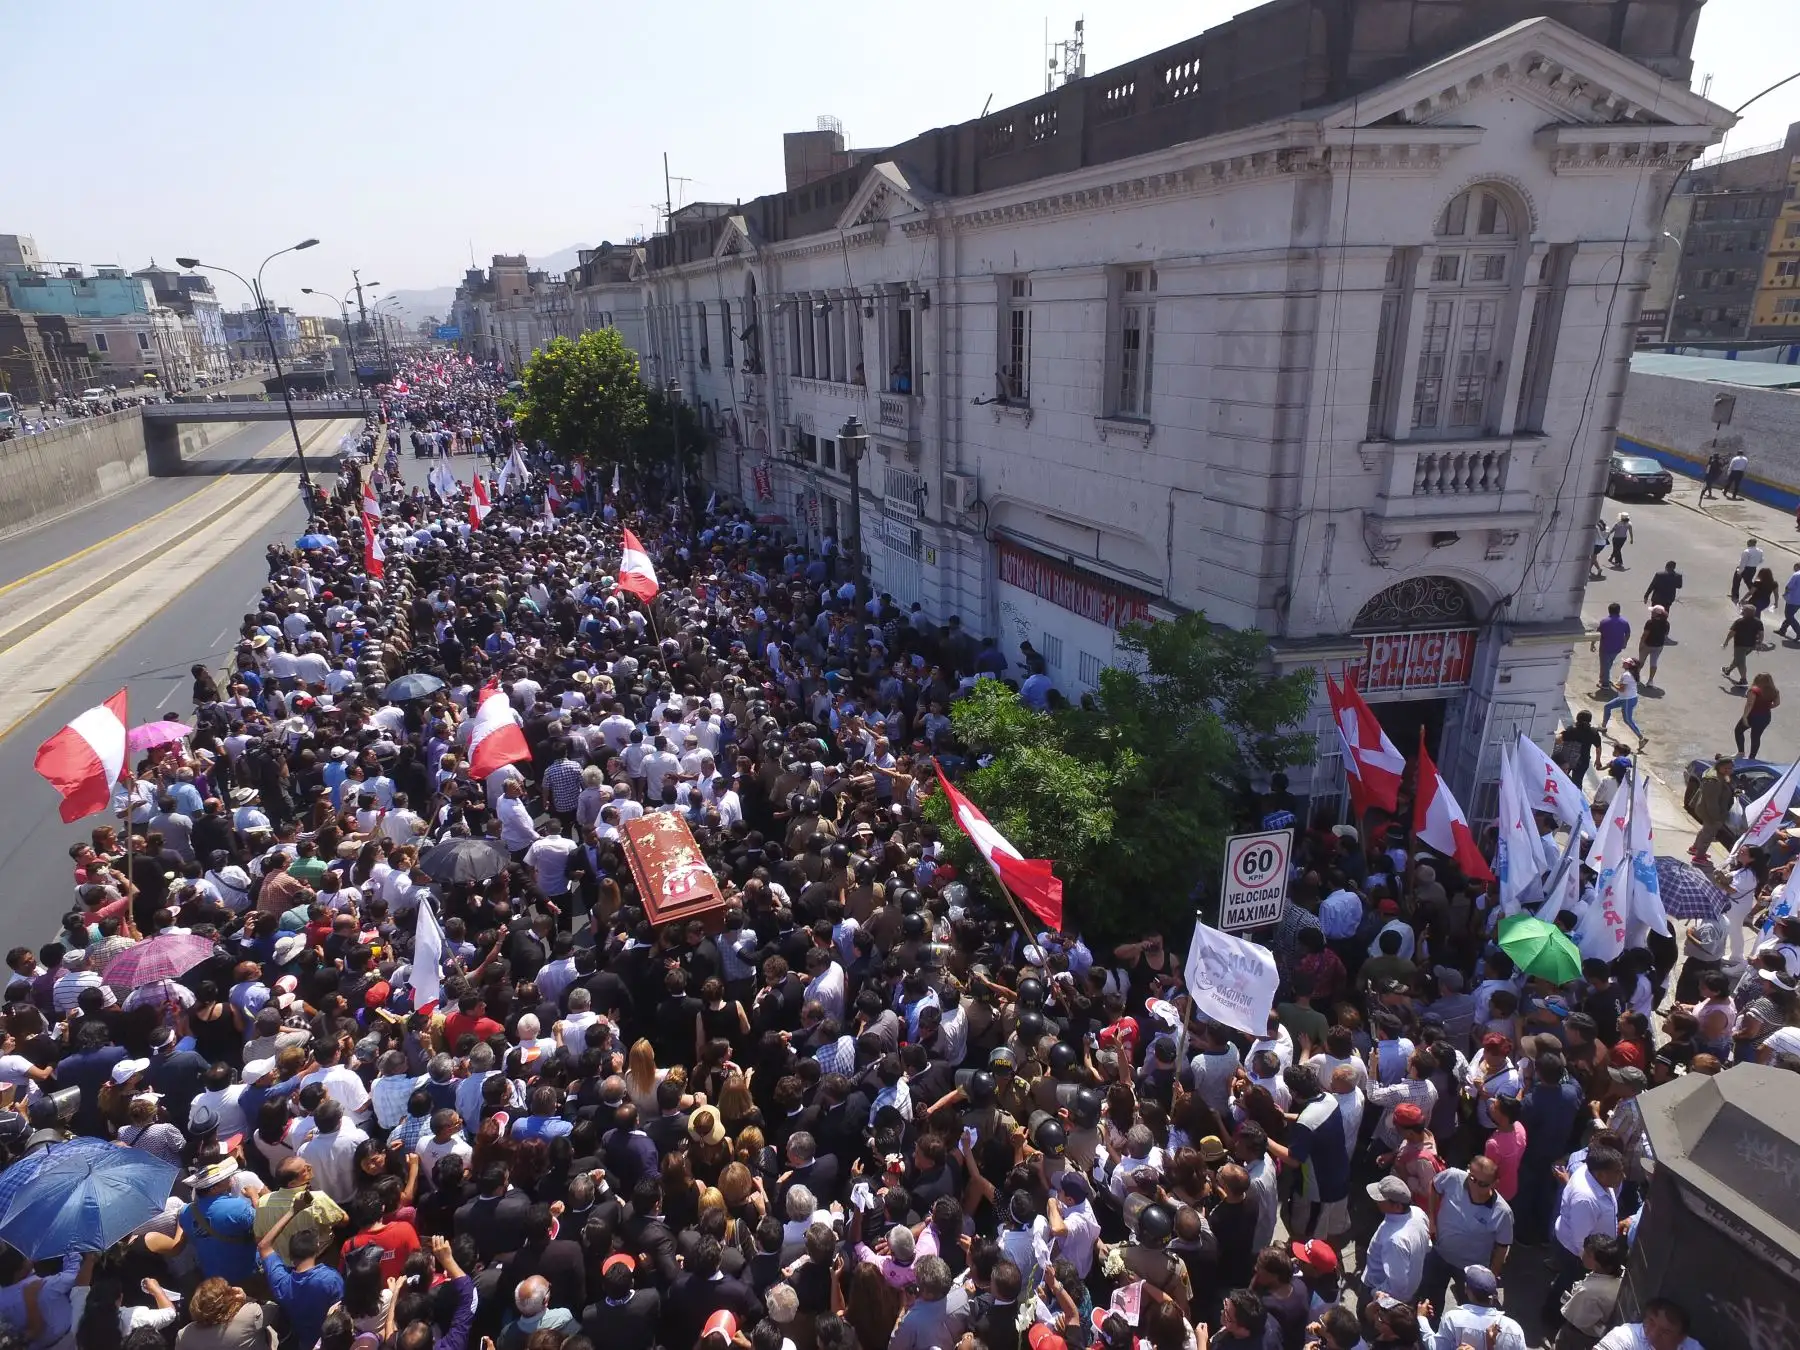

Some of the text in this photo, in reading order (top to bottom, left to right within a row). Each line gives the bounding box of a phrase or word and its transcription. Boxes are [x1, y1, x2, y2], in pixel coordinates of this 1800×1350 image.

[1002, 552, 1035, 593] BOTICAS
[1360, 664, 1448, 682] 24 HORAS
[1242, 849, 1273, 875] 60
[1229, 887, 1280, 905] VELOCIDAD
[1227, 903, 1276, 924] MAXIMA
